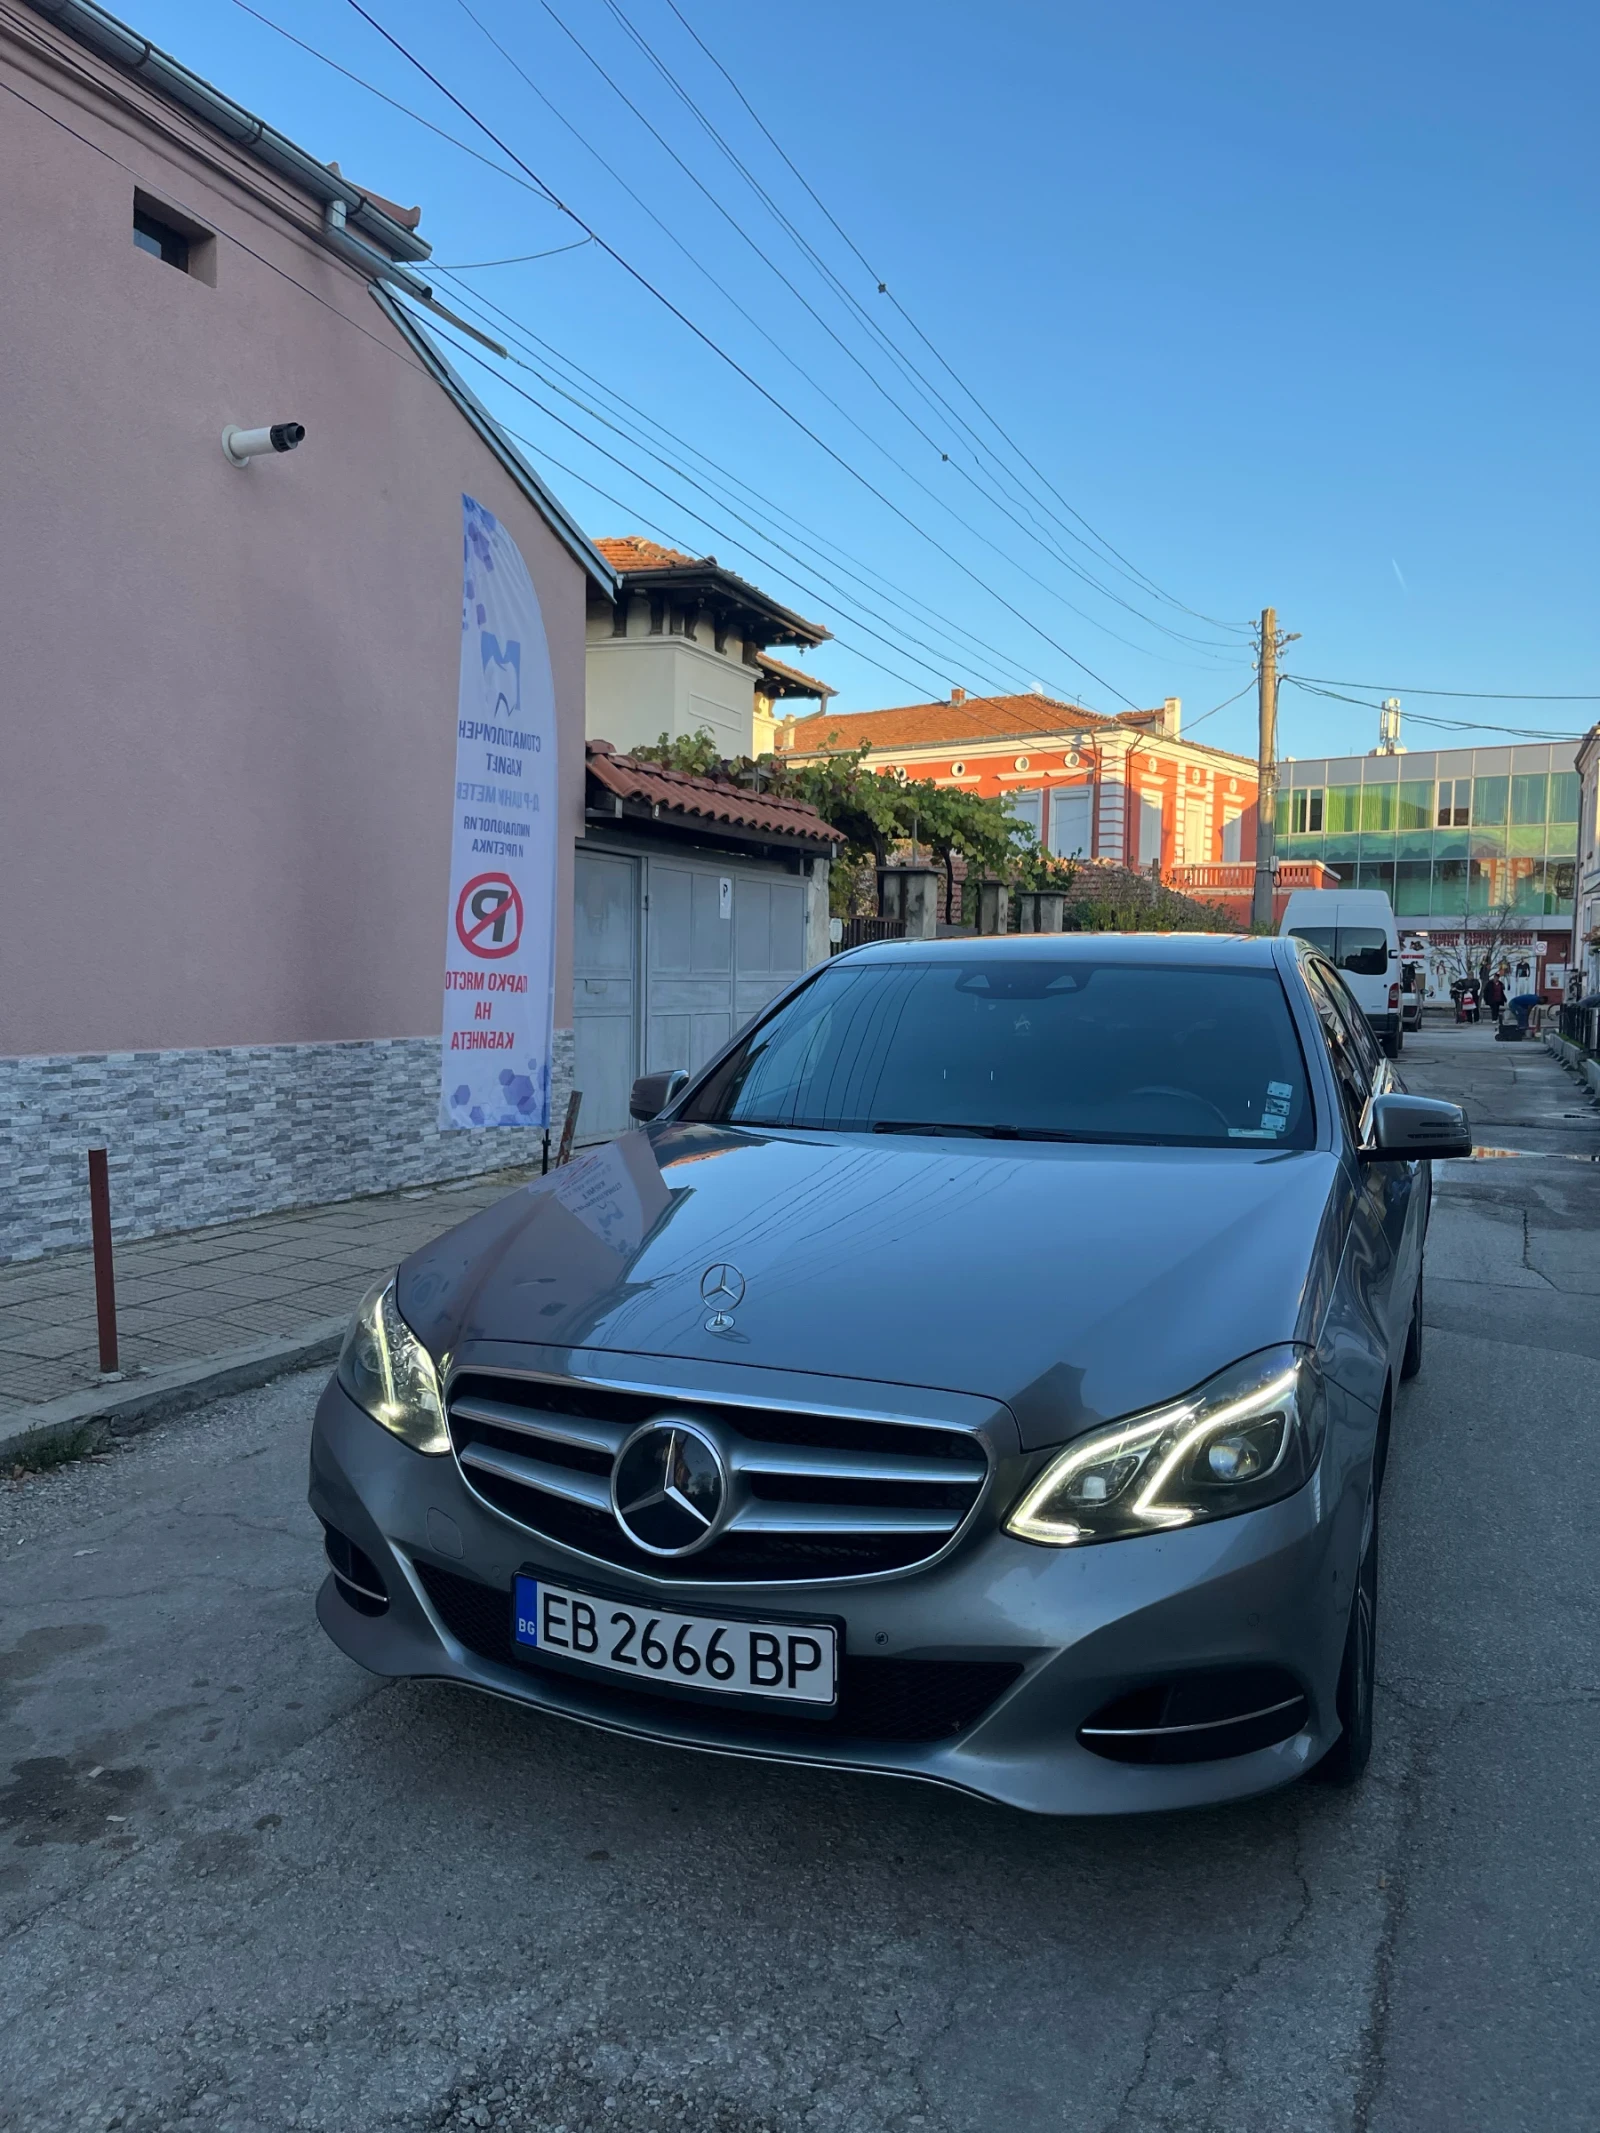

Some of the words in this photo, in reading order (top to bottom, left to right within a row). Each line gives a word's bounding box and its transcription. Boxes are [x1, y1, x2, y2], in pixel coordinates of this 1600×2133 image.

[518, 1618, 536, 1636] BG
[542, 1591, 599, 1654] EB
[610, 1611, 736, 1681] 2666
[749, 1630, 822, 1690] BP
